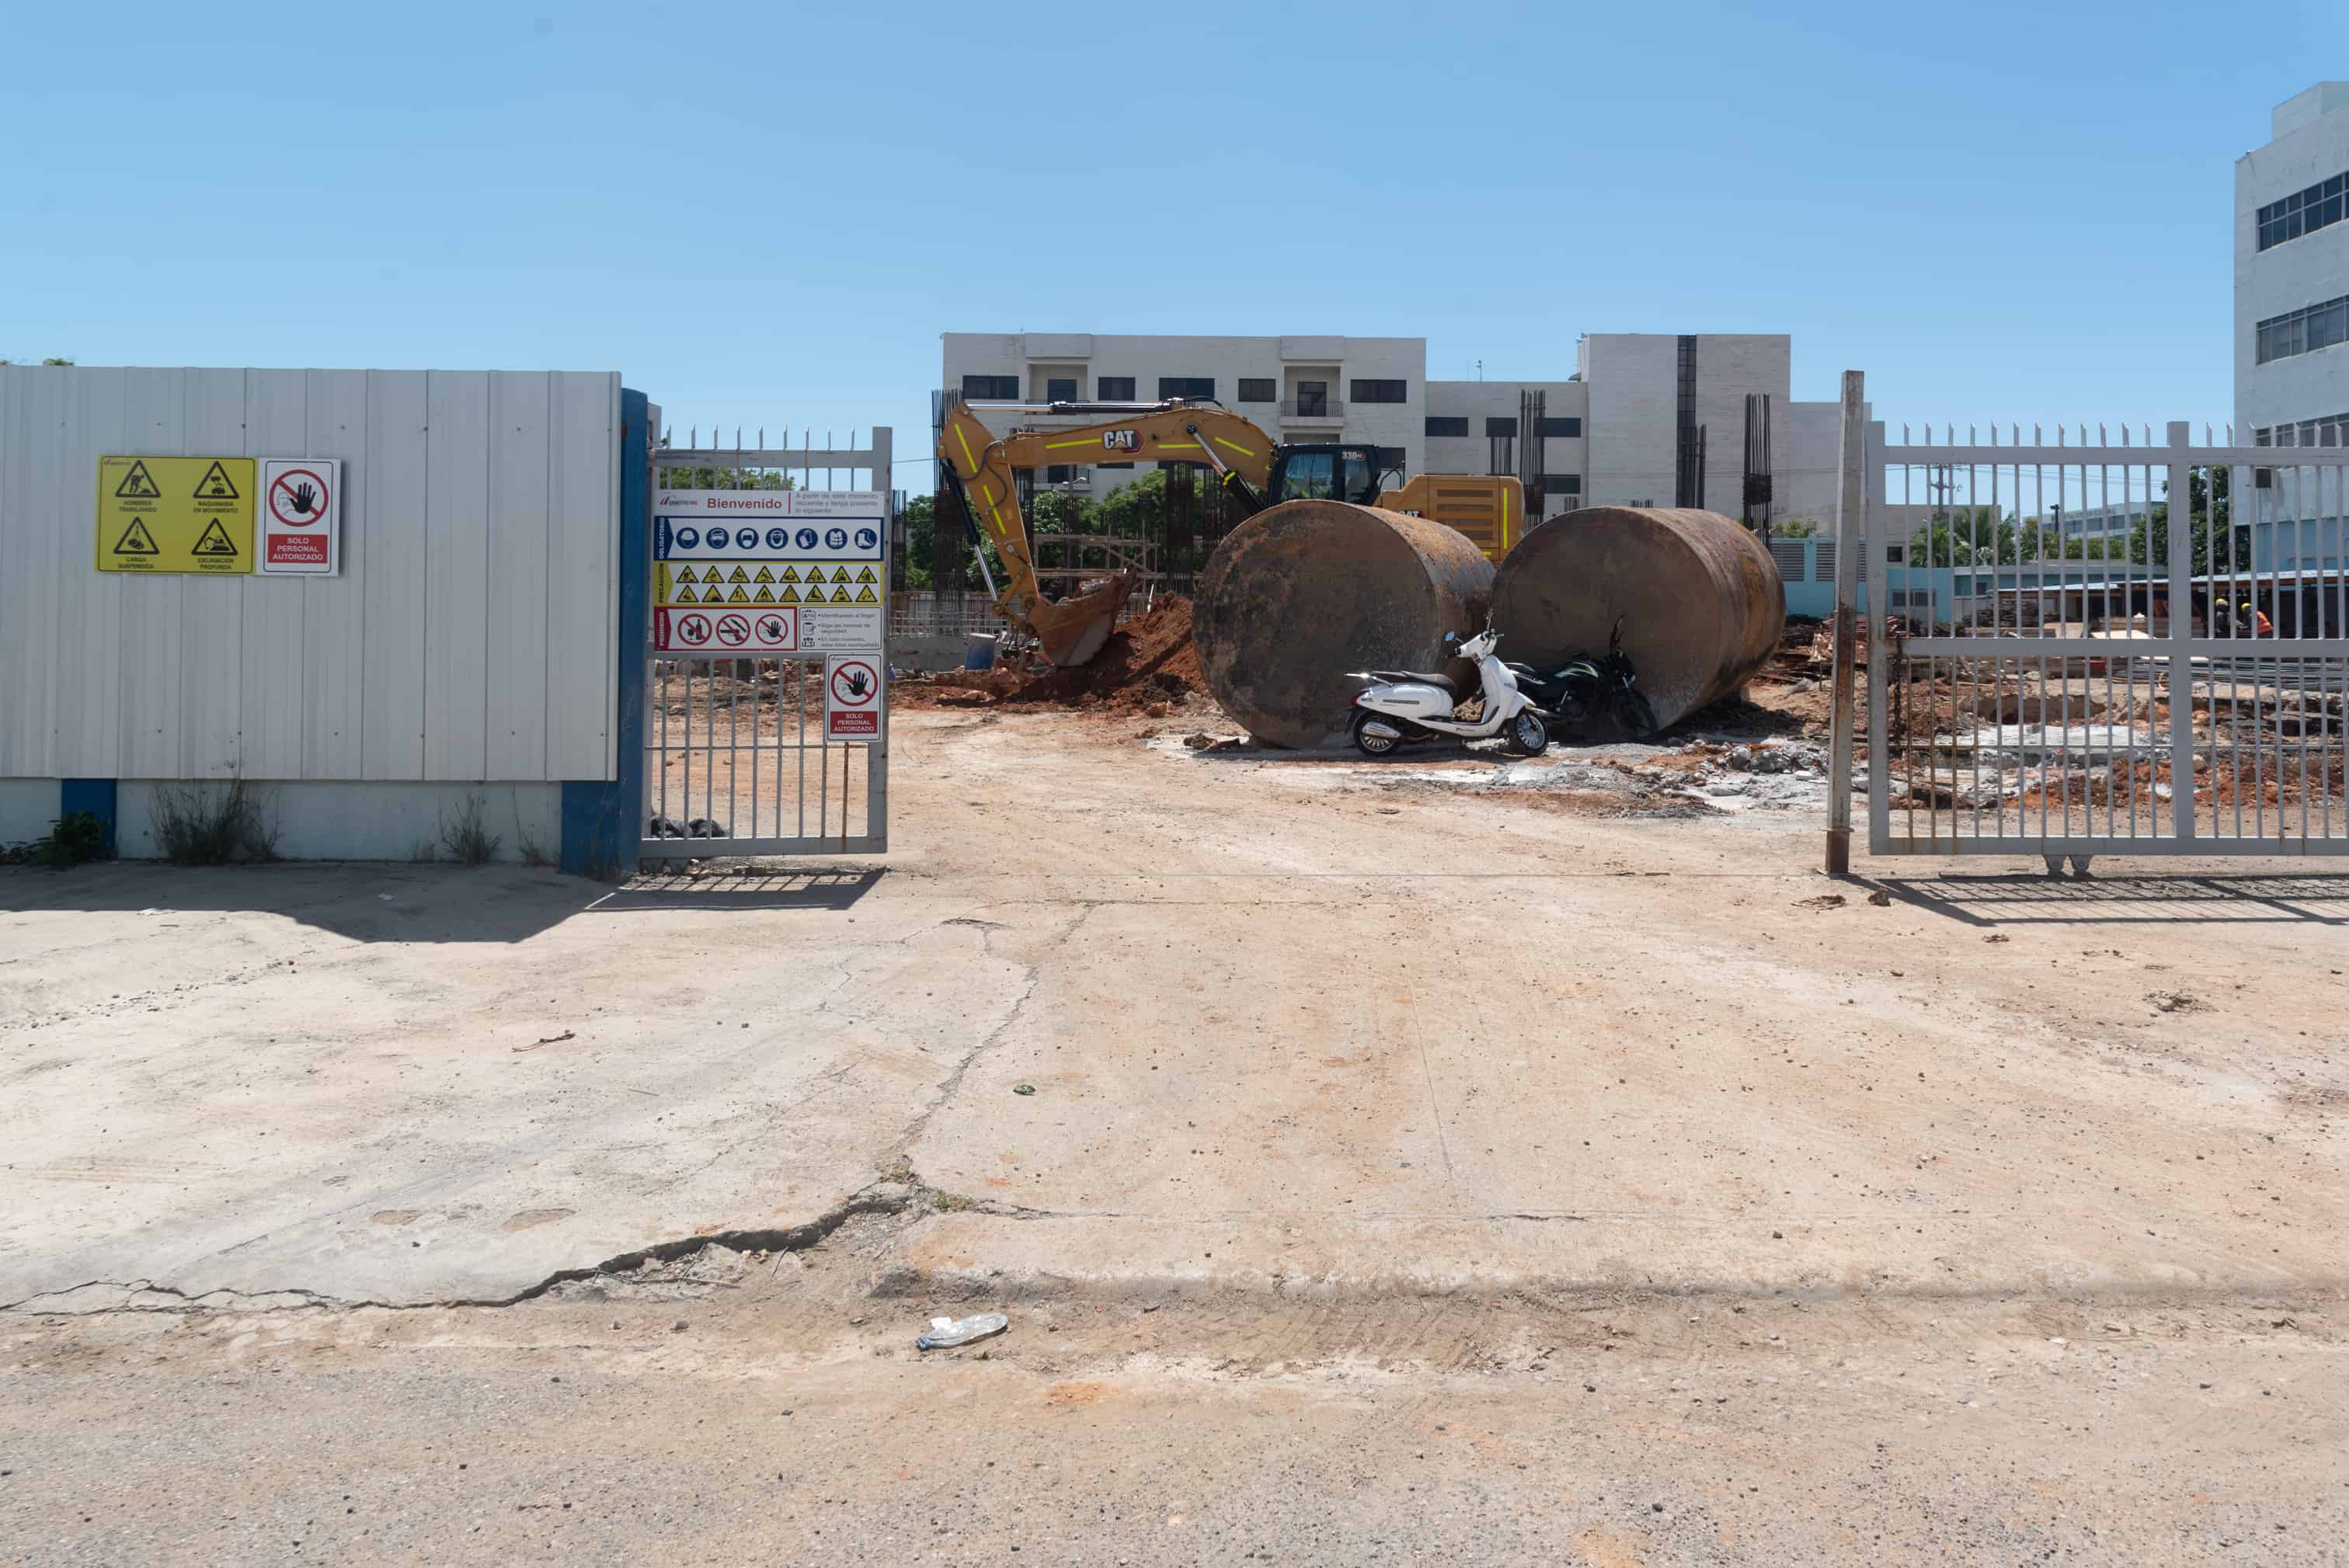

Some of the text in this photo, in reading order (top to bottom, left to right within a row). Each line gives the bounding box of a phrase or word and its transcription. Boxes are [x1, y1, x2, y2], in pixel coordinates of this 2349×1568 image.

[1104, 430, 1134, 449] CAT
[1342, 451, 1356, 460] 330
[708, 498, 782, 509] Bienvenido
